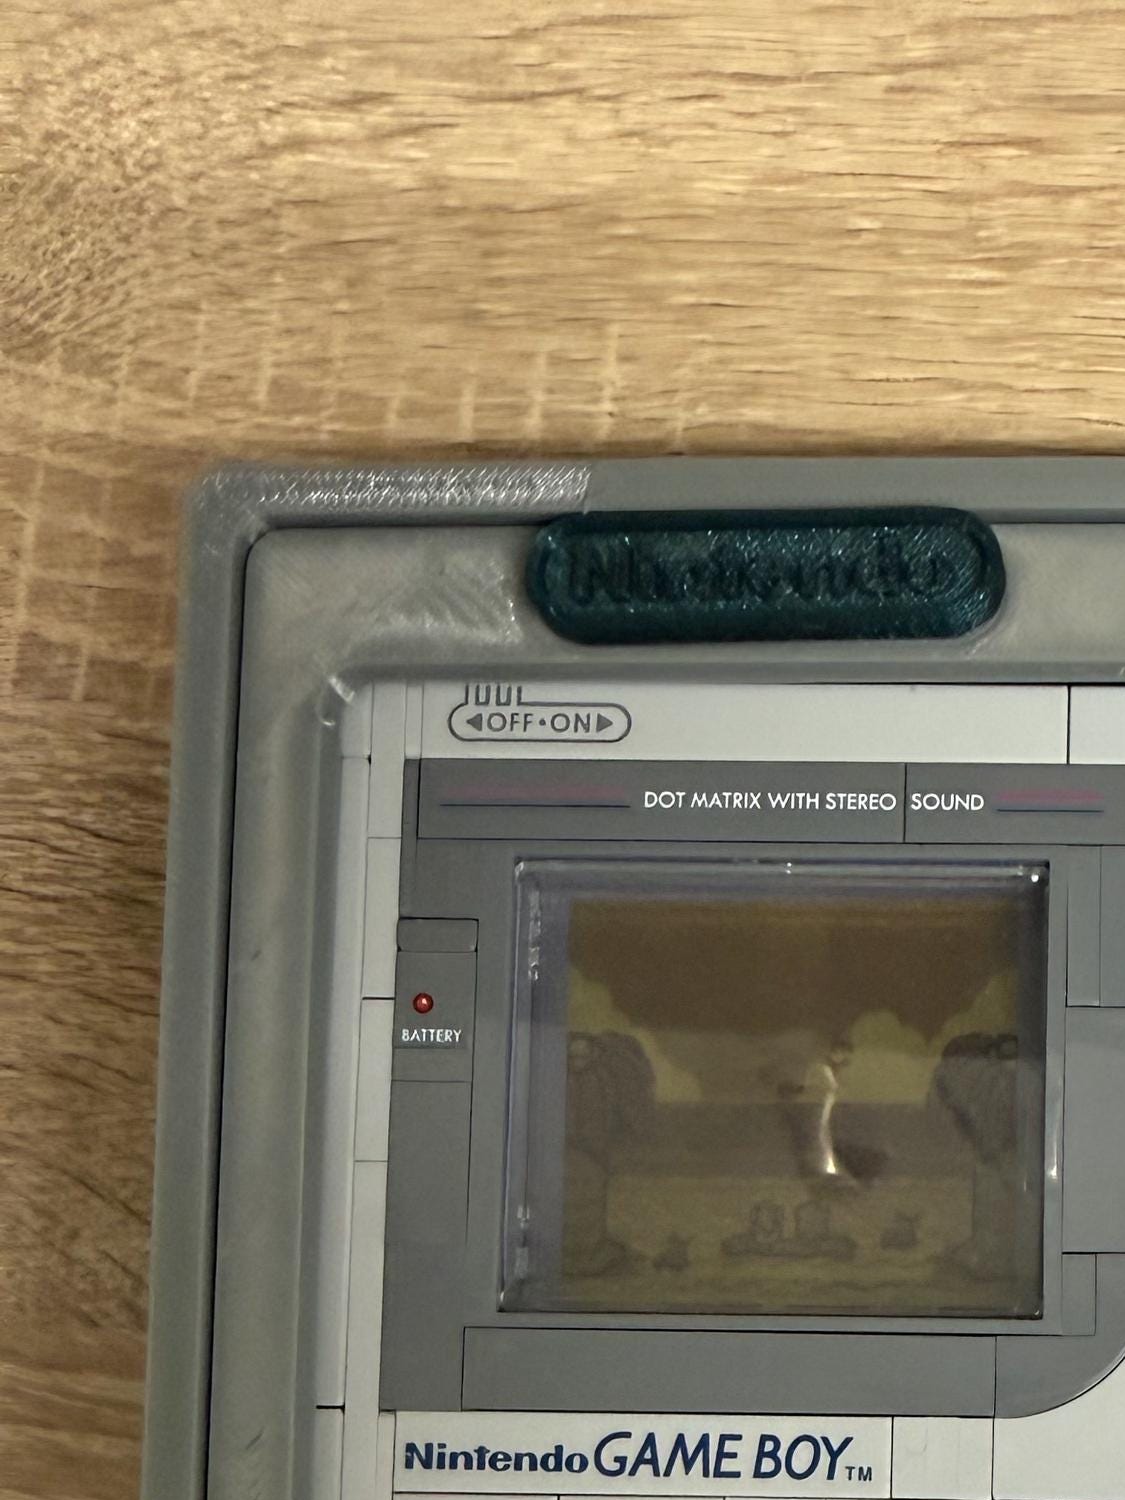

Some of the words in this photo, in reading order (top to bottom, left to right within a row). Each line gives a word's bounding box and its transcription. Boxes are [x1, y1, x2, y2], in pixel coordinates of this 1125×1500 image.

[486, 712, 533, 732] OFF
[550, 712, 592, 733] ON
[644, 791, 686, 809] DOT
[690, 791, 762, 809] MATRIX
[767, 792, 820, 810] WITH
[825, 792, 897, 811] STEREO
[911, 793, 985, 811] SOUND
[401, 1028, 462, 1043] BATTERY
[404, 1441, 589, 1474] Nintendo
[594, 1431, 743, 1479] GAME
[752, 1434, 854, 1481] BOY
